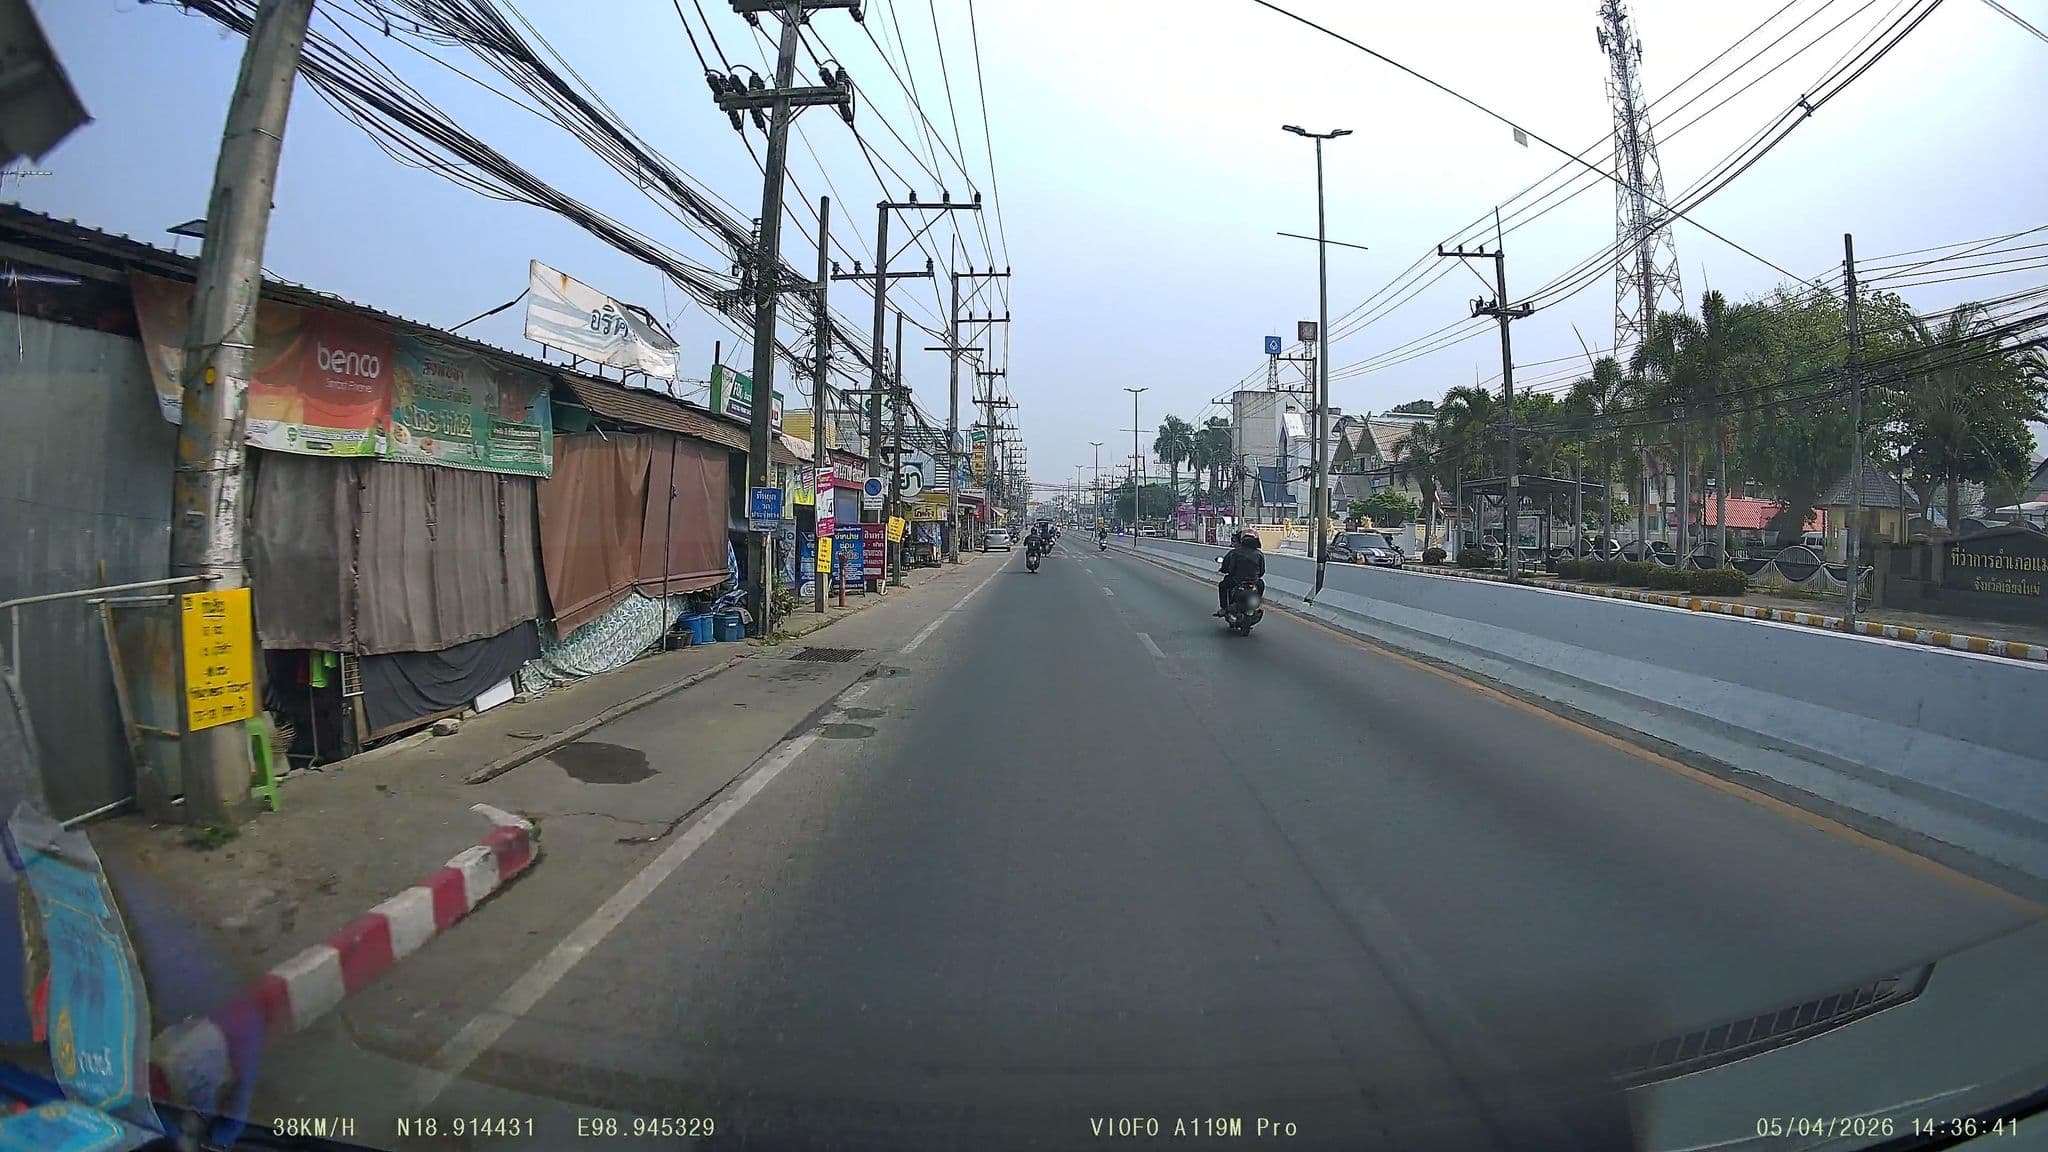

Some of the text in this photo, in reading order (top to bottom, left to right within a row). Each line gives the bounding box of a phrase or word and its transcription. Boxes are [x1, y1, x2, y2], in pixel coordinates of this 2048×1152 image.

[317, 341, 379, 378] benco
[828, 501, 833, 515] 4
[1974, 576, 2041, 596] จังหวัดเชียงใหม่
